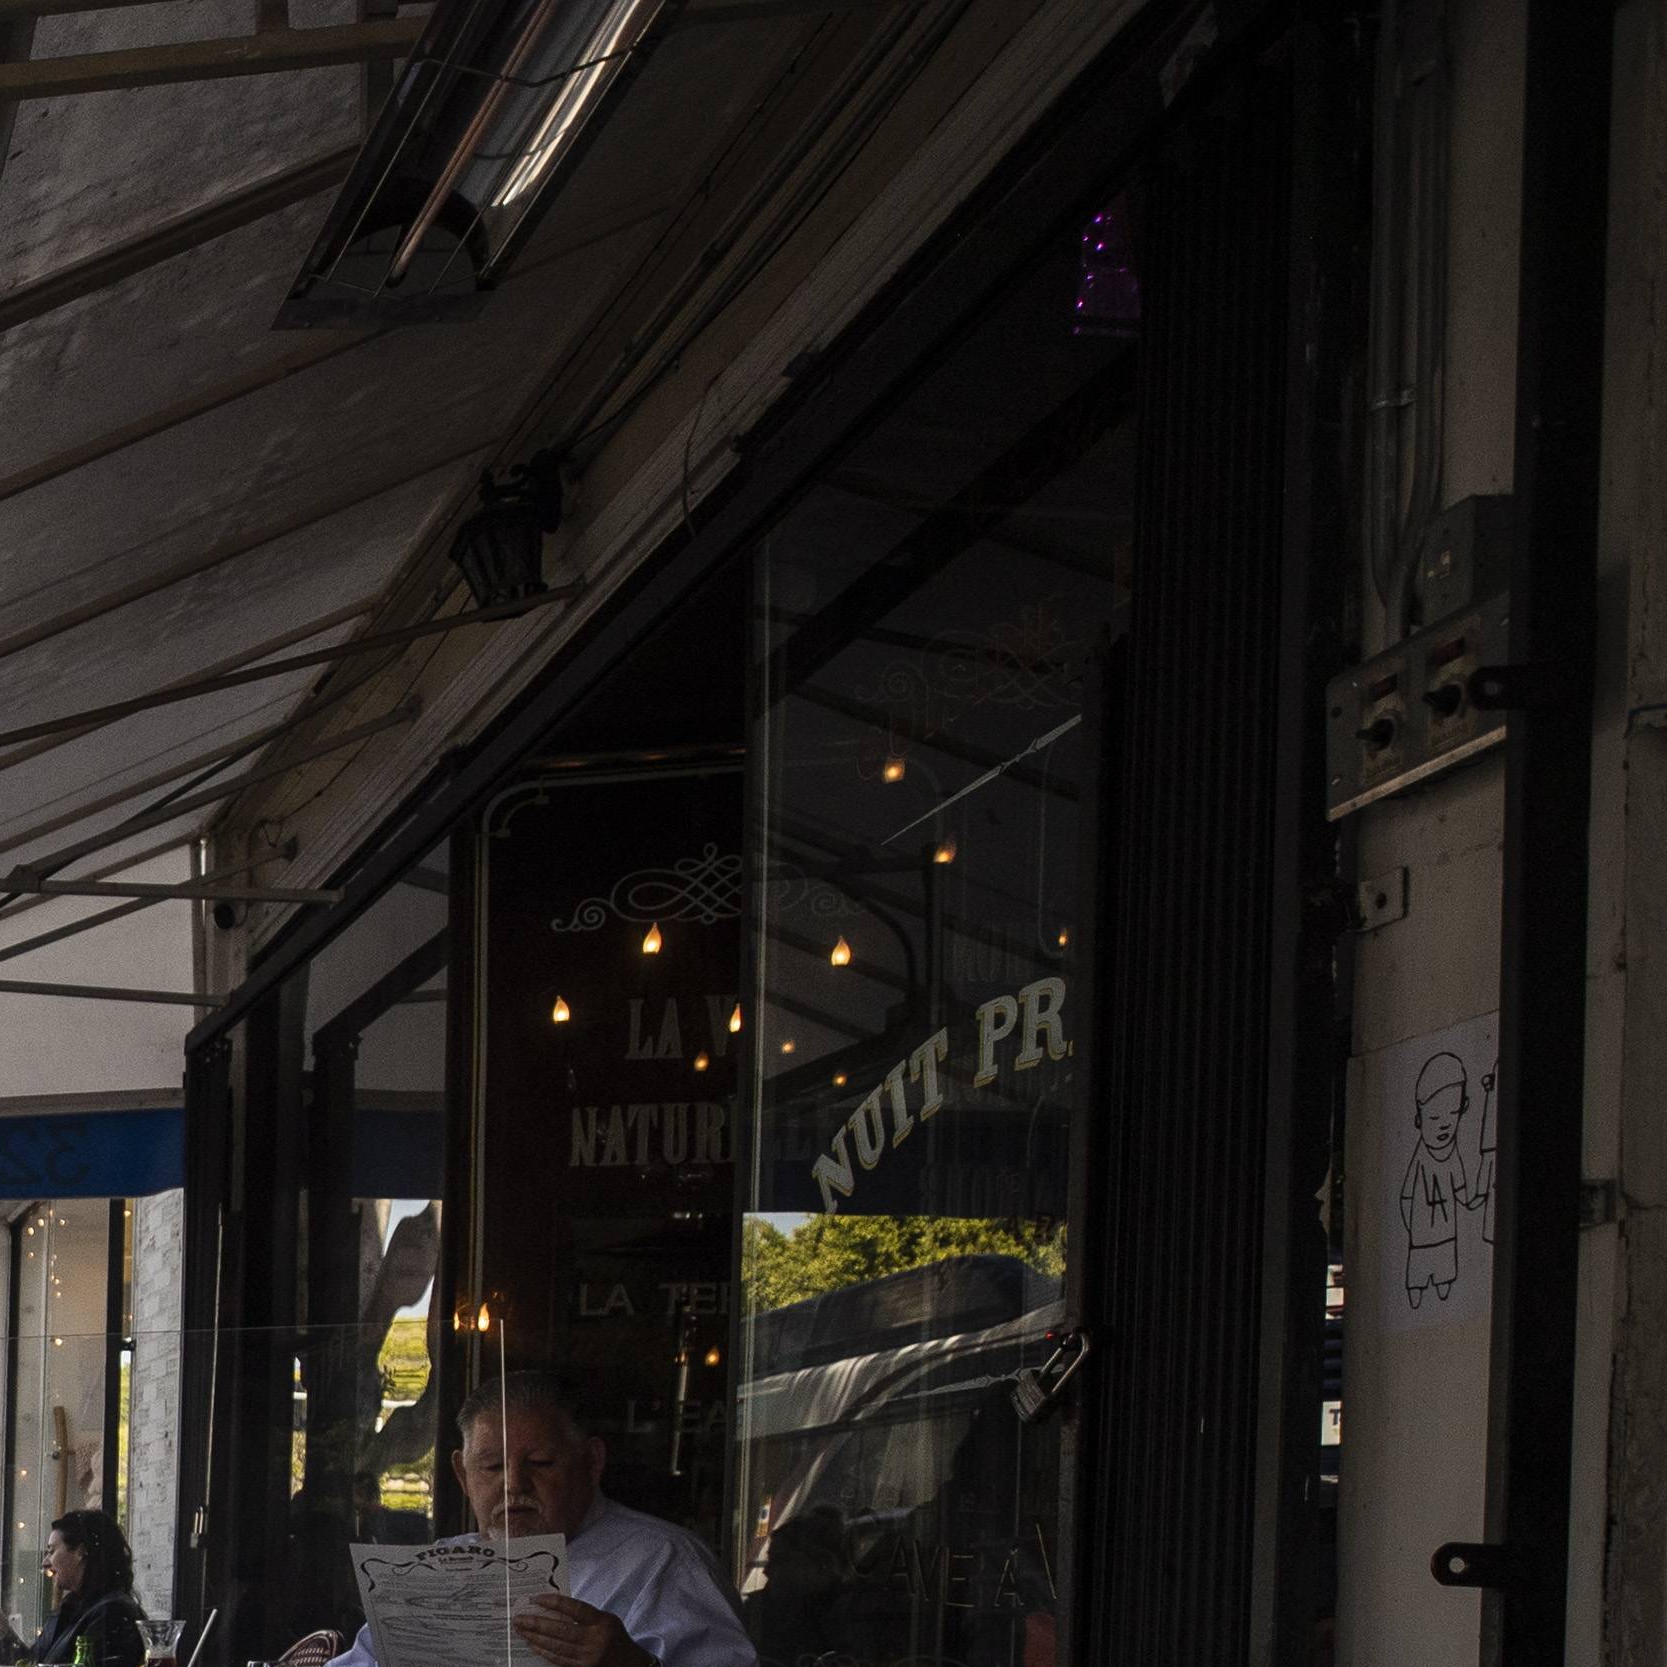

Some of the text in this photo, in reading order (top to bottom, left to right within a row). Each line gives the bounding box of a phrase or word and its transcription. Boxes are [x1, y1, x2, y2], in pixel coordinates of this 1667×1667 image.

[623, 997, 684, 1060] LA
[811, 1027, 948, 1214] NUIT
[973, 976, 1071, 1088] PR
[579, 1283, 635, 1318] LA
[415, 1546, 496, 1561] FIGARO
